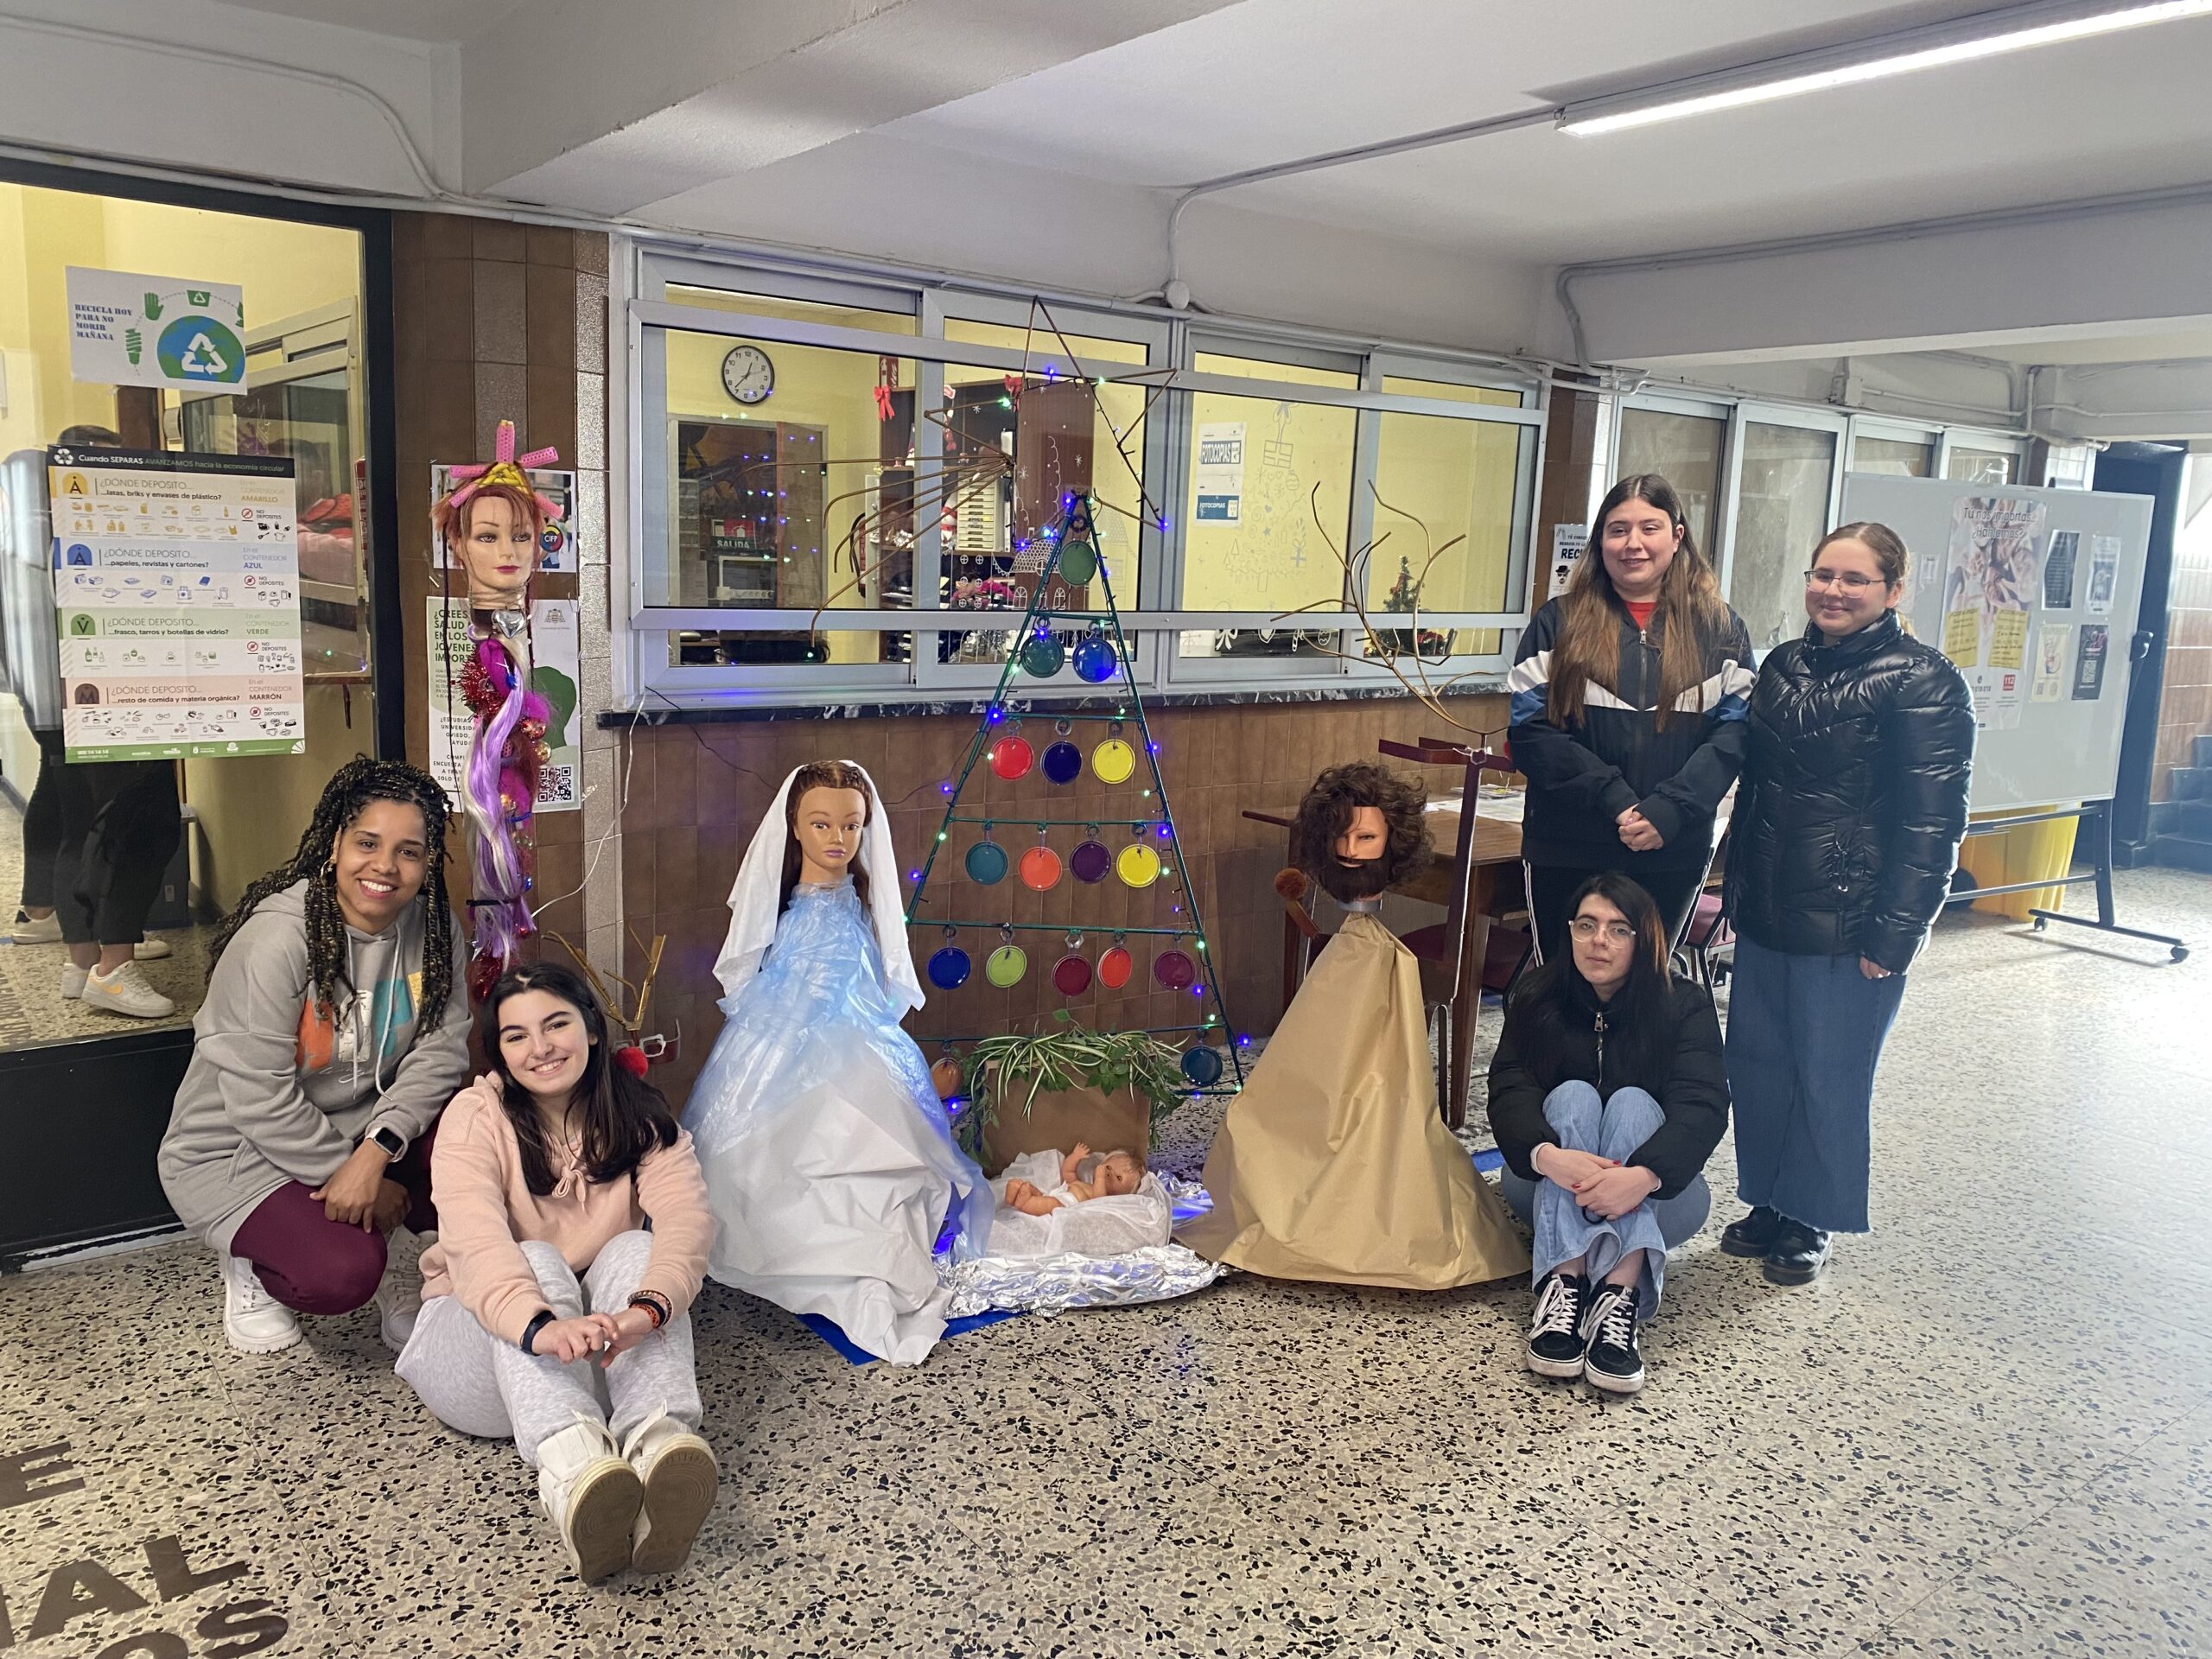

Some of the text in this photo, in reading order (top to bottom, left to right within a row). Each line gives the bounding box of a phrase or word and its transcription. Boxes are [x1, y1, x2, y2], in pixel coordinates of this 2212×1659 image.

[74, 304, 112, 314] RECICLA
[75, 313, 99, 321] PARA
[76, 330, 114, 340] MAÑANA
[1202, 444, 1231, 463] FOTOCOPIAS
[79, 454, 109, 463] Cuando
[145, 459, 194, 467] AVANZAMOS
[1963, 507, 1974, 518] Tú
[717, 539, 750, 549] SALIDA
[448, 632, 467, 640] LOS
[435, 653, 470, 662] IMOR
